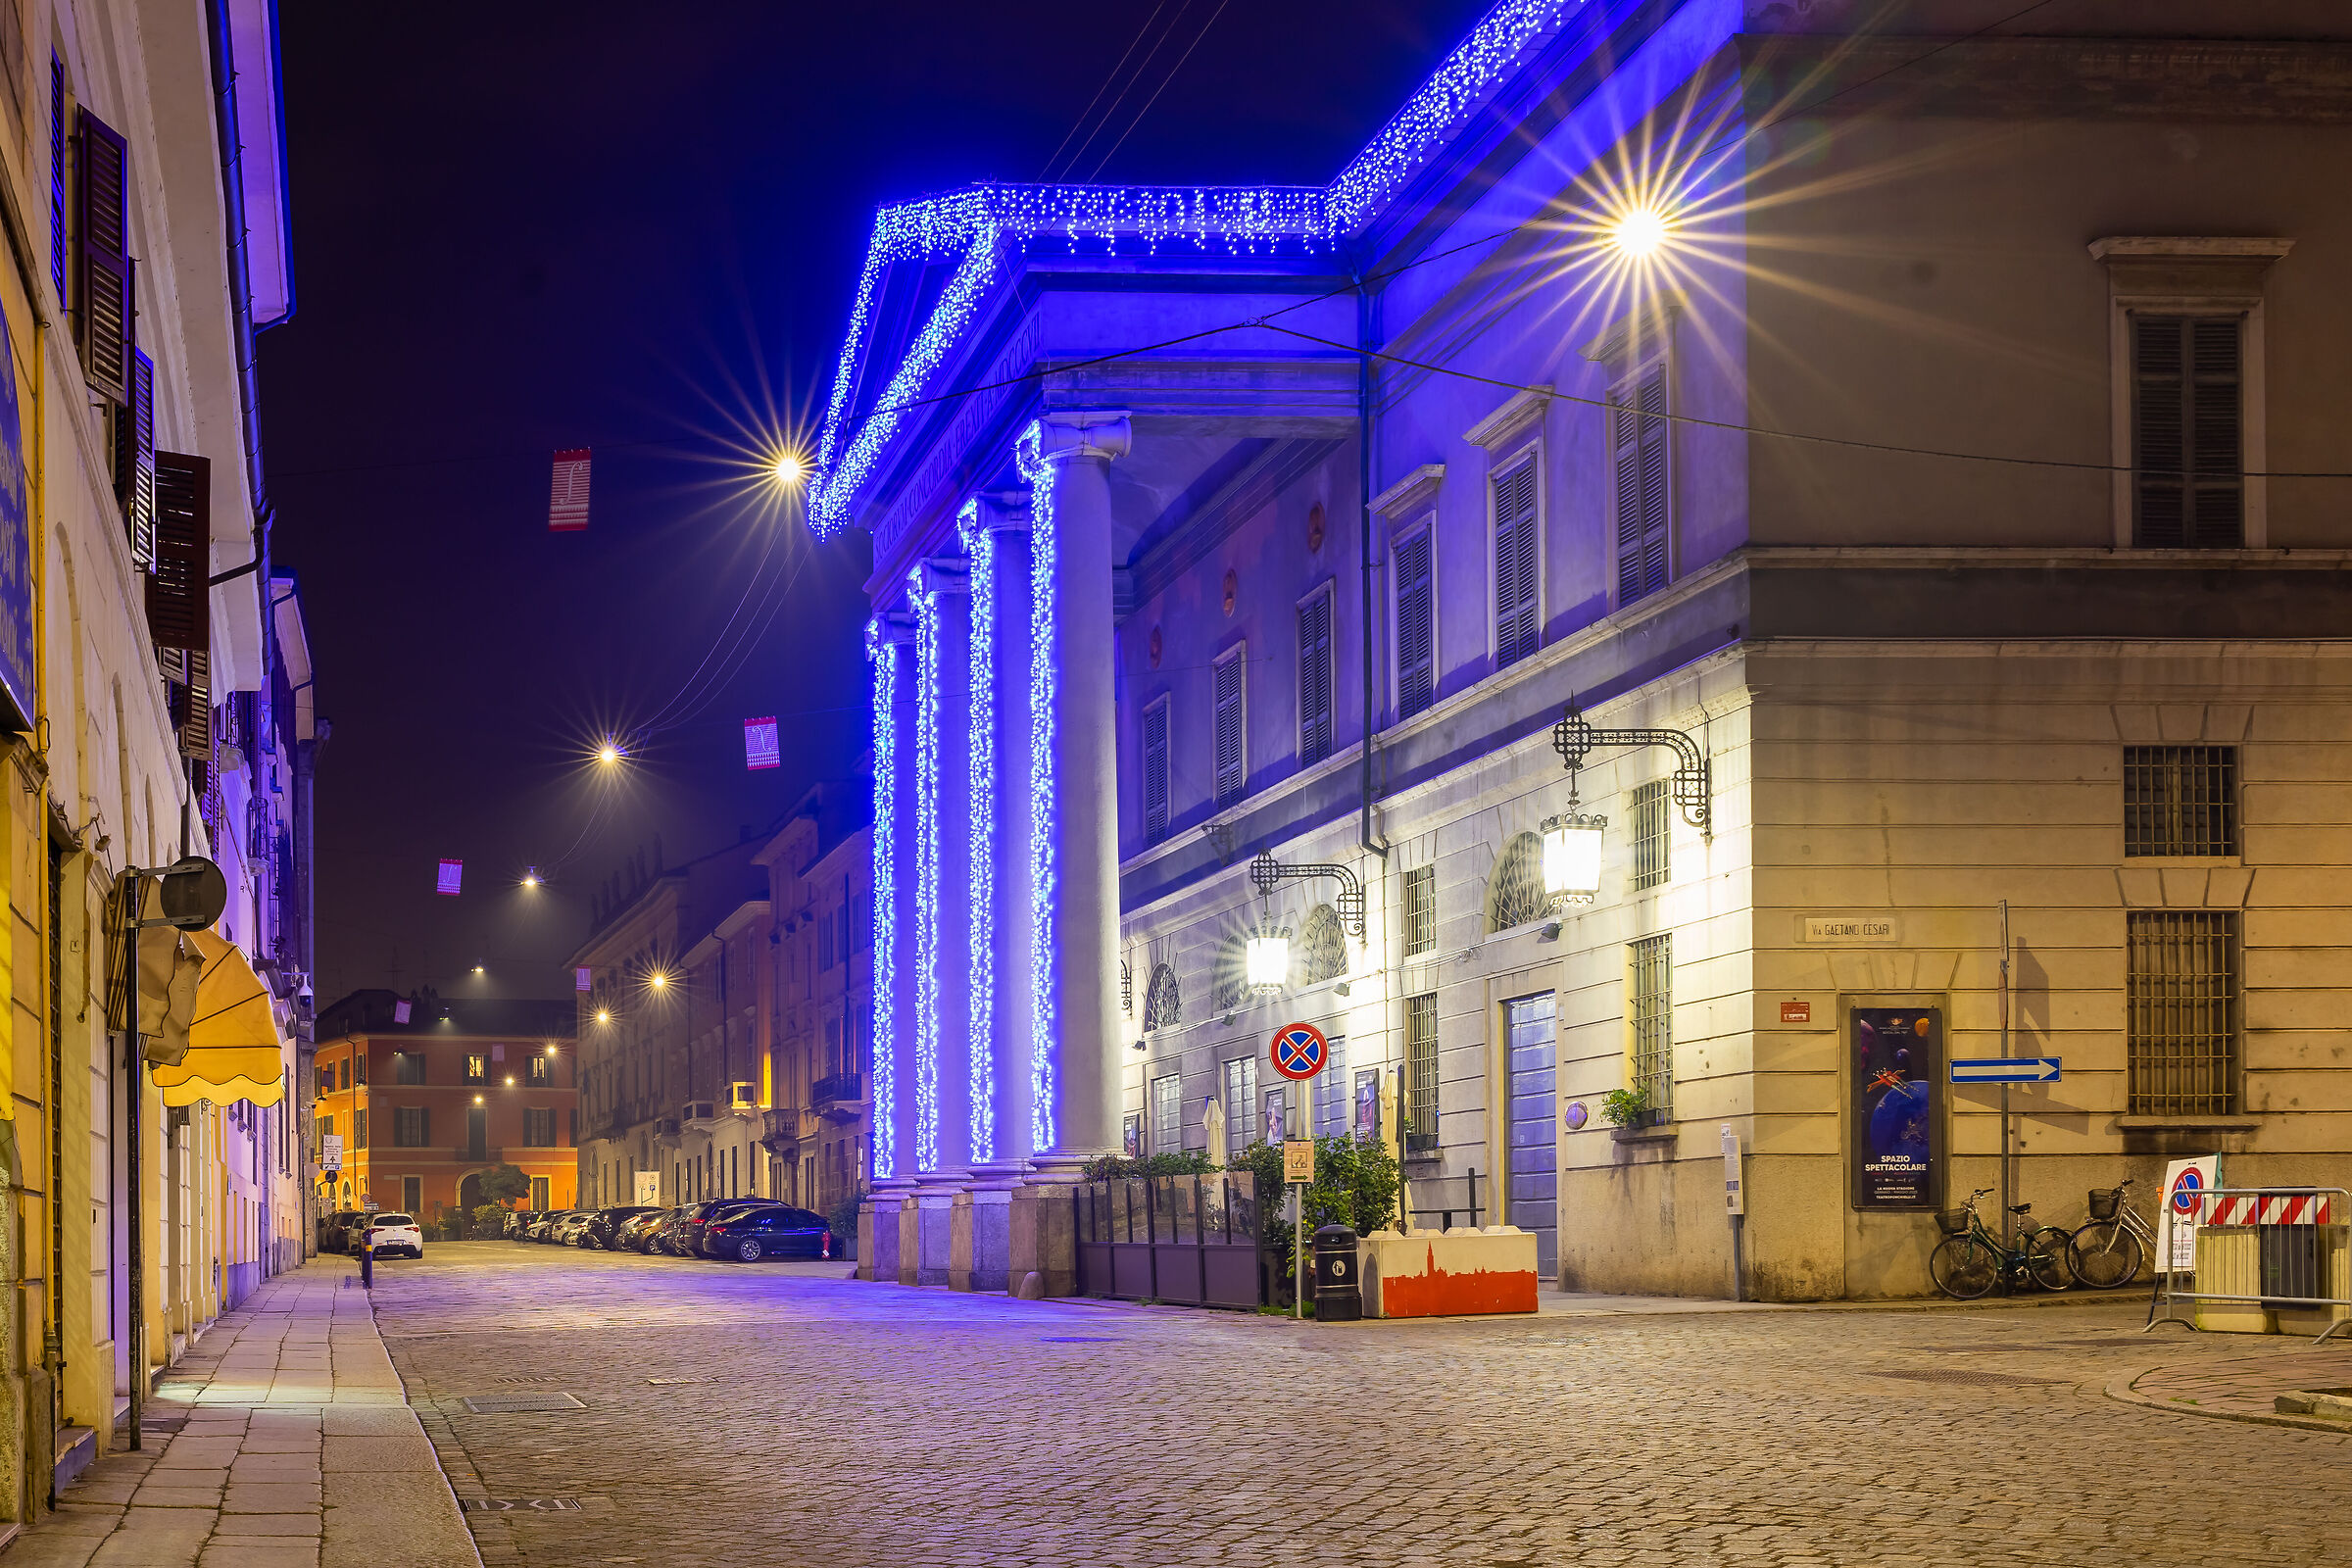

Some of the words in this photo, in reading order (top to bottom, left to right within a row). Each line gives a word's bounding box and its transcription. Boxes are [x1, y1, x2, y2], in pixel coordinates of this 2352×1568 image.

[1825, 924, 1860, 936] GAETANO
[1863, 923, 1890, 936] CESARI
[1881, 1154, 1911, 1163] SPAZIO
[1865, 1163, 1927, 1172] SPETTACOLARE
